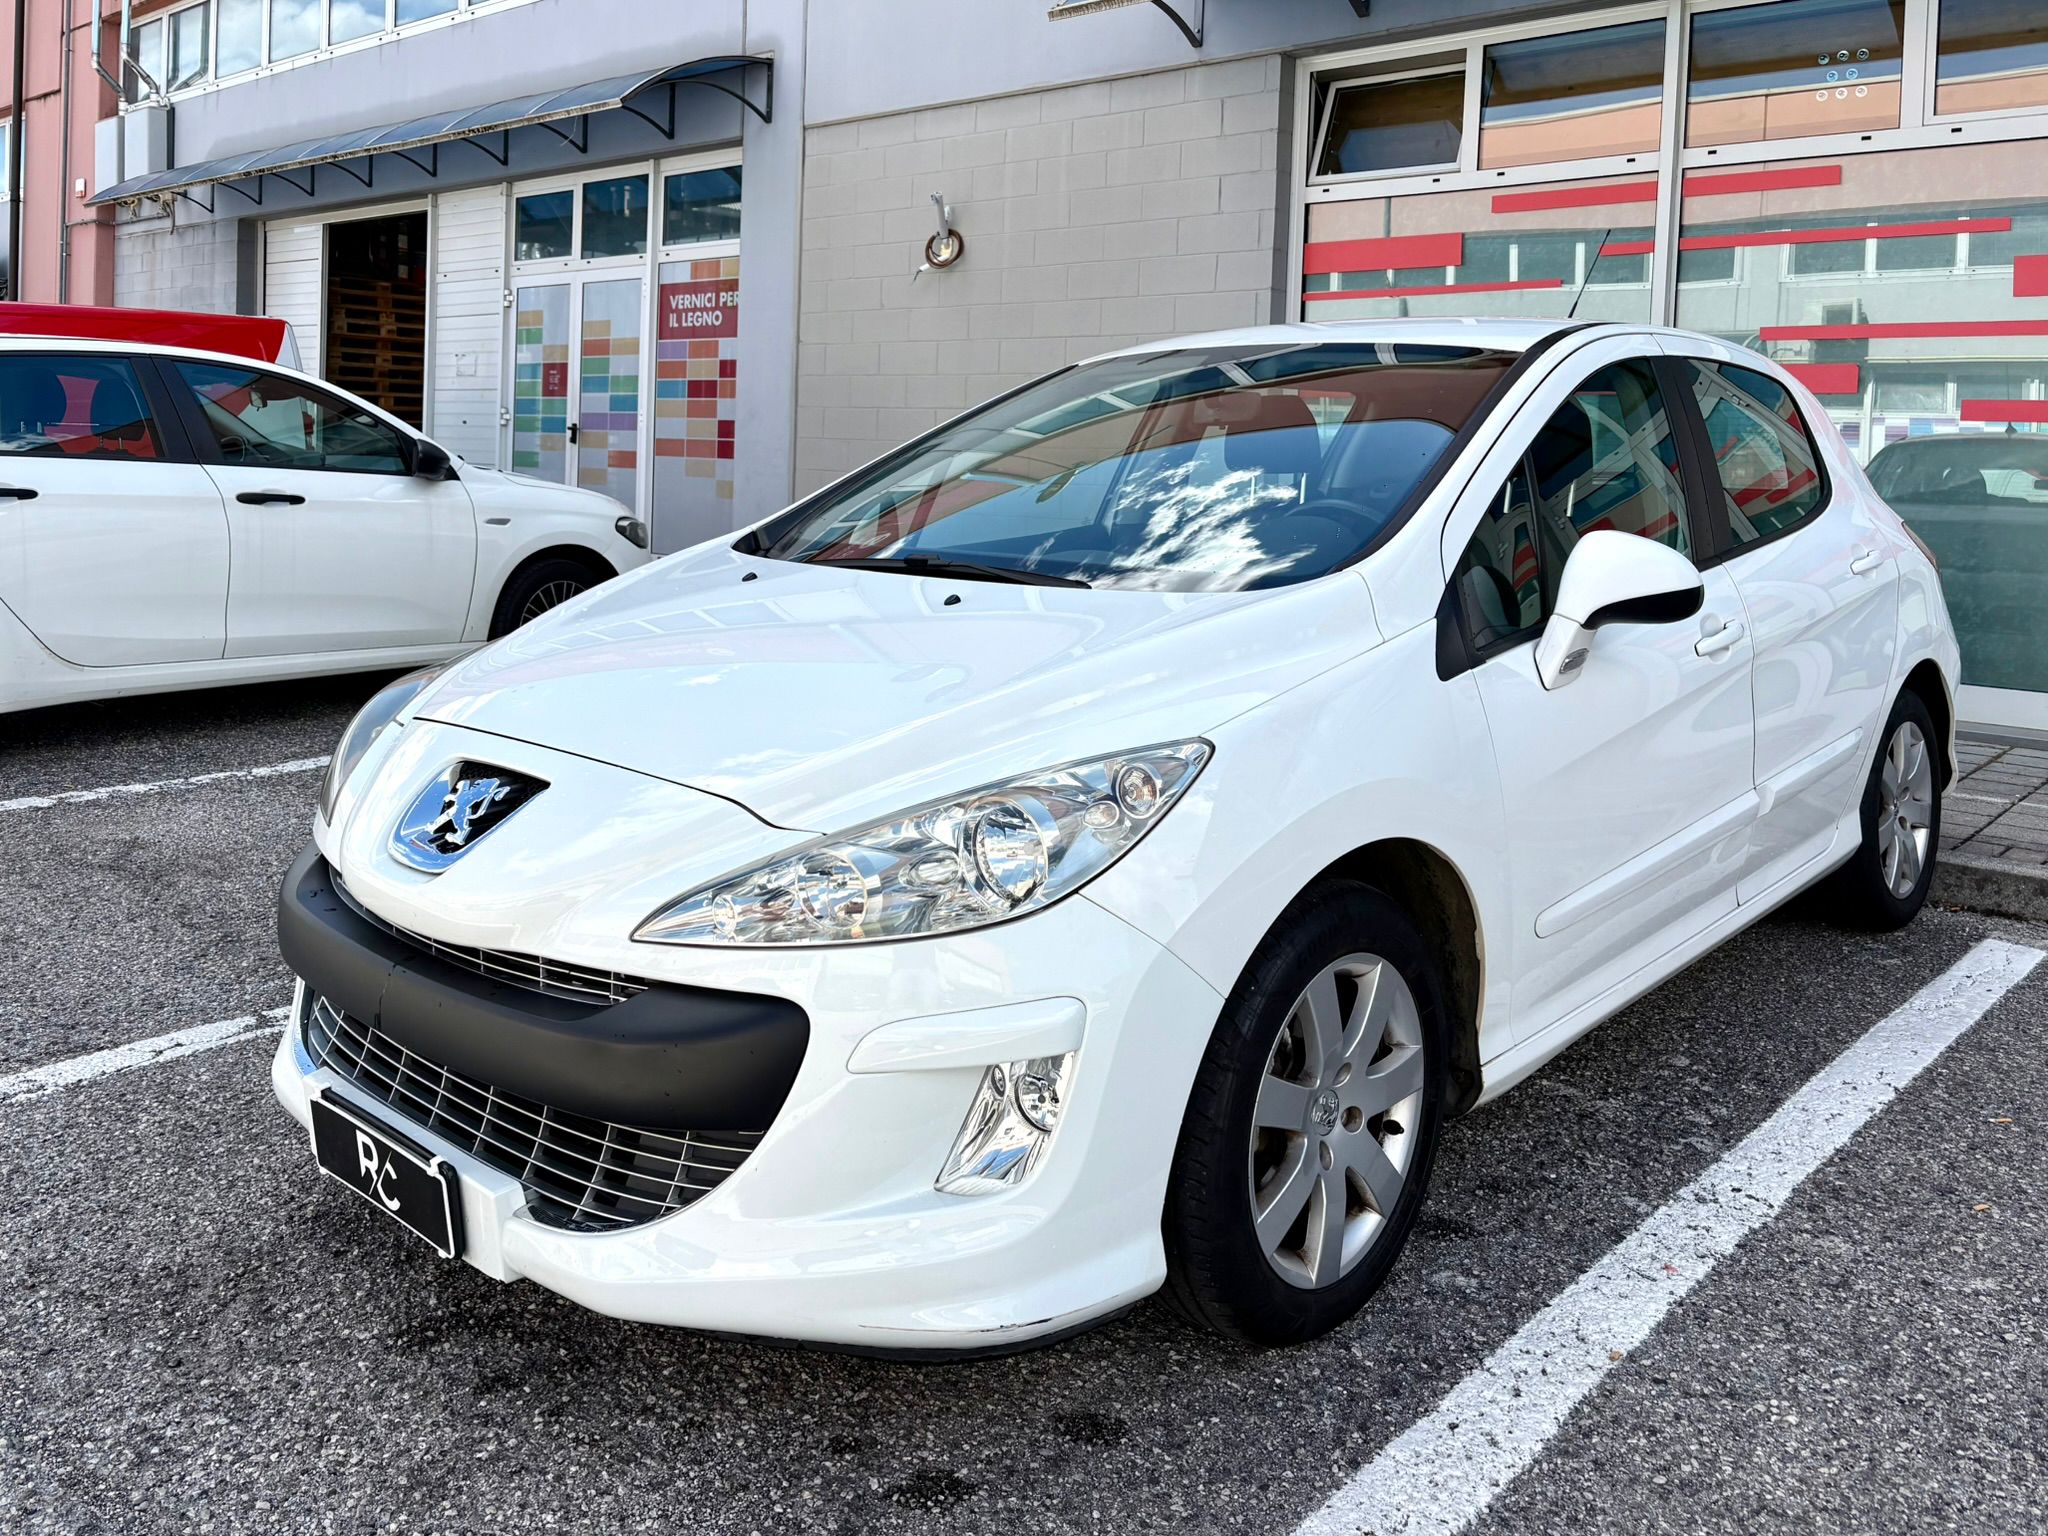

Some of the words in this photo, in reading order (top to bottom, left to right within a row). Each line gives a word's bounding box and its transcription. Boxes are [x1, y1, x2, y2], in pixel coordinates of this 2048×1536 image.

[669, 292, 716, 309] VERNICI
[719, 291, 739, 307] PER
[669, 313, 679, 328] IL
[682, 310, 723, 327] LEGNO
